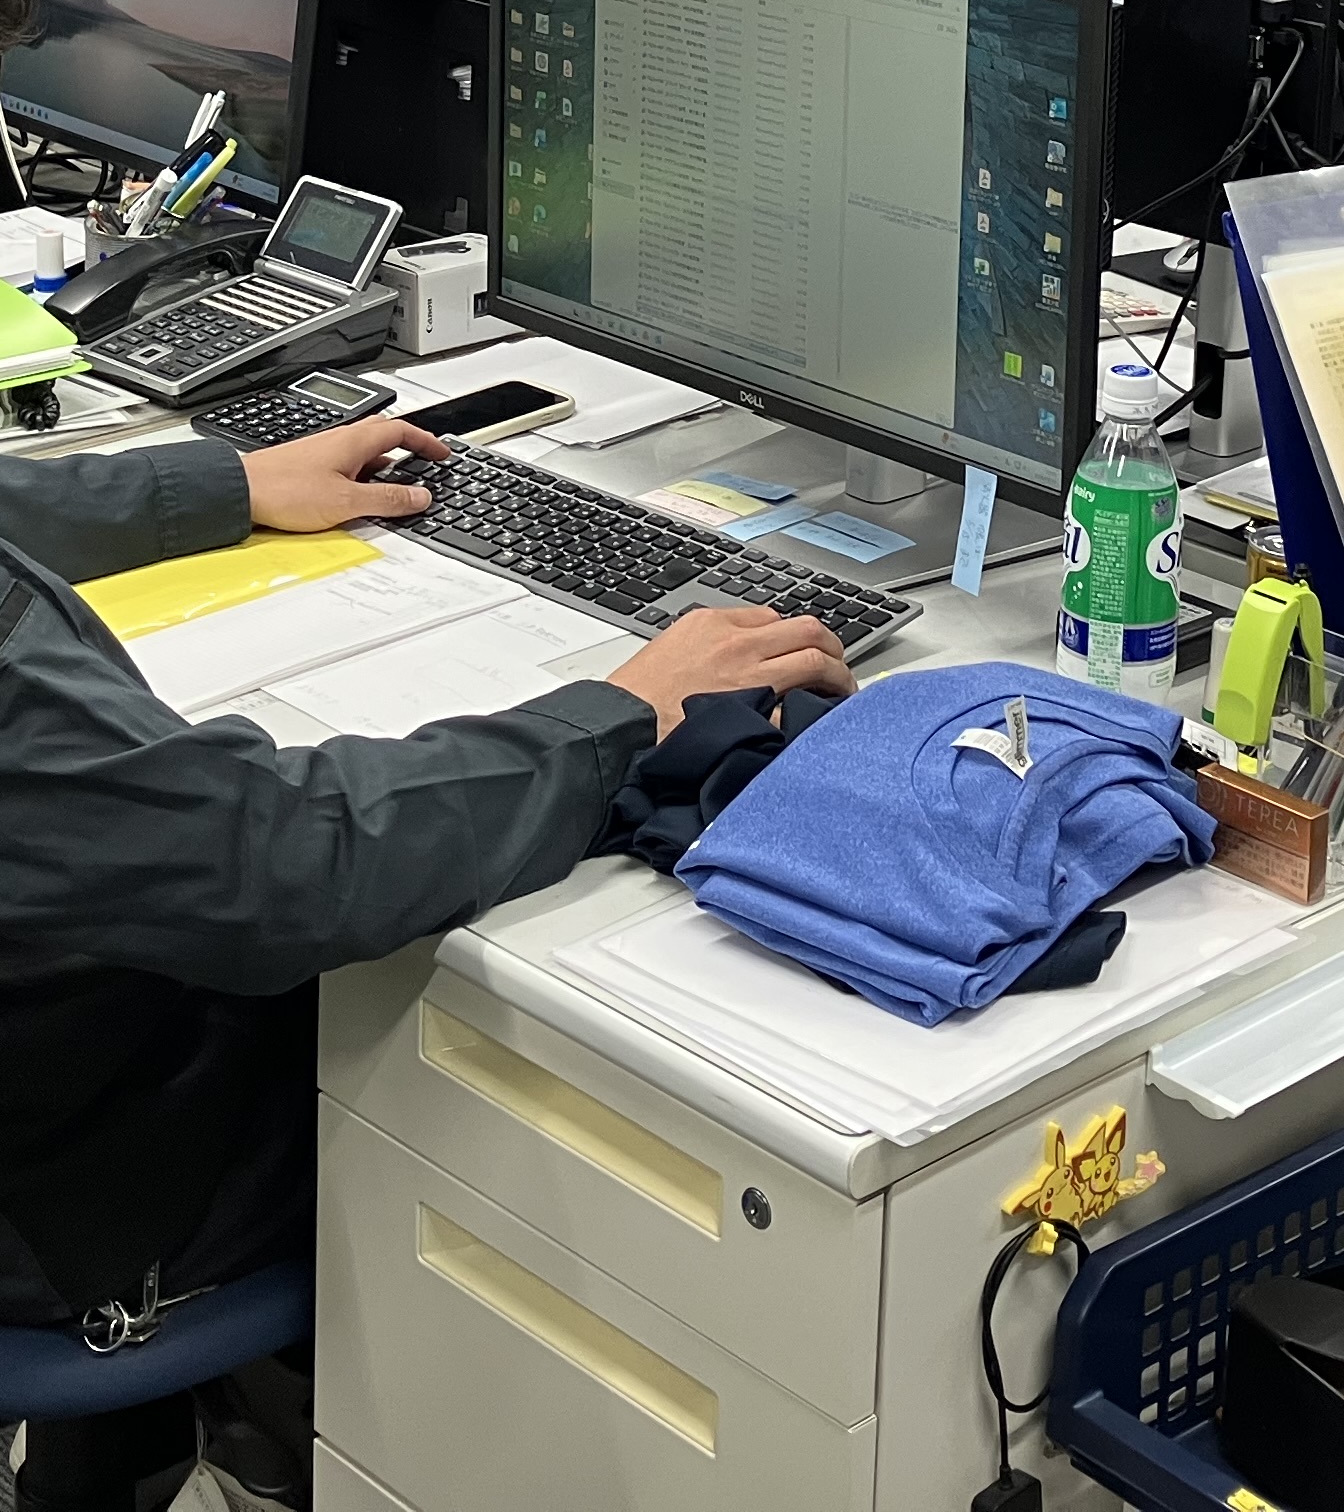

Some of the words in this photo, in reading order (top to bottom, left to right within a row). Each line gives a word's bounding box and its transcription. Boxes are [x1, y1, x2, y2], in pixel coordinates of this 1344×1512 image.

[425, 297, 434, 334] Canon
[739, 390, 765, 409] DELL
[1233, 792, 1299, 839] TEREA
